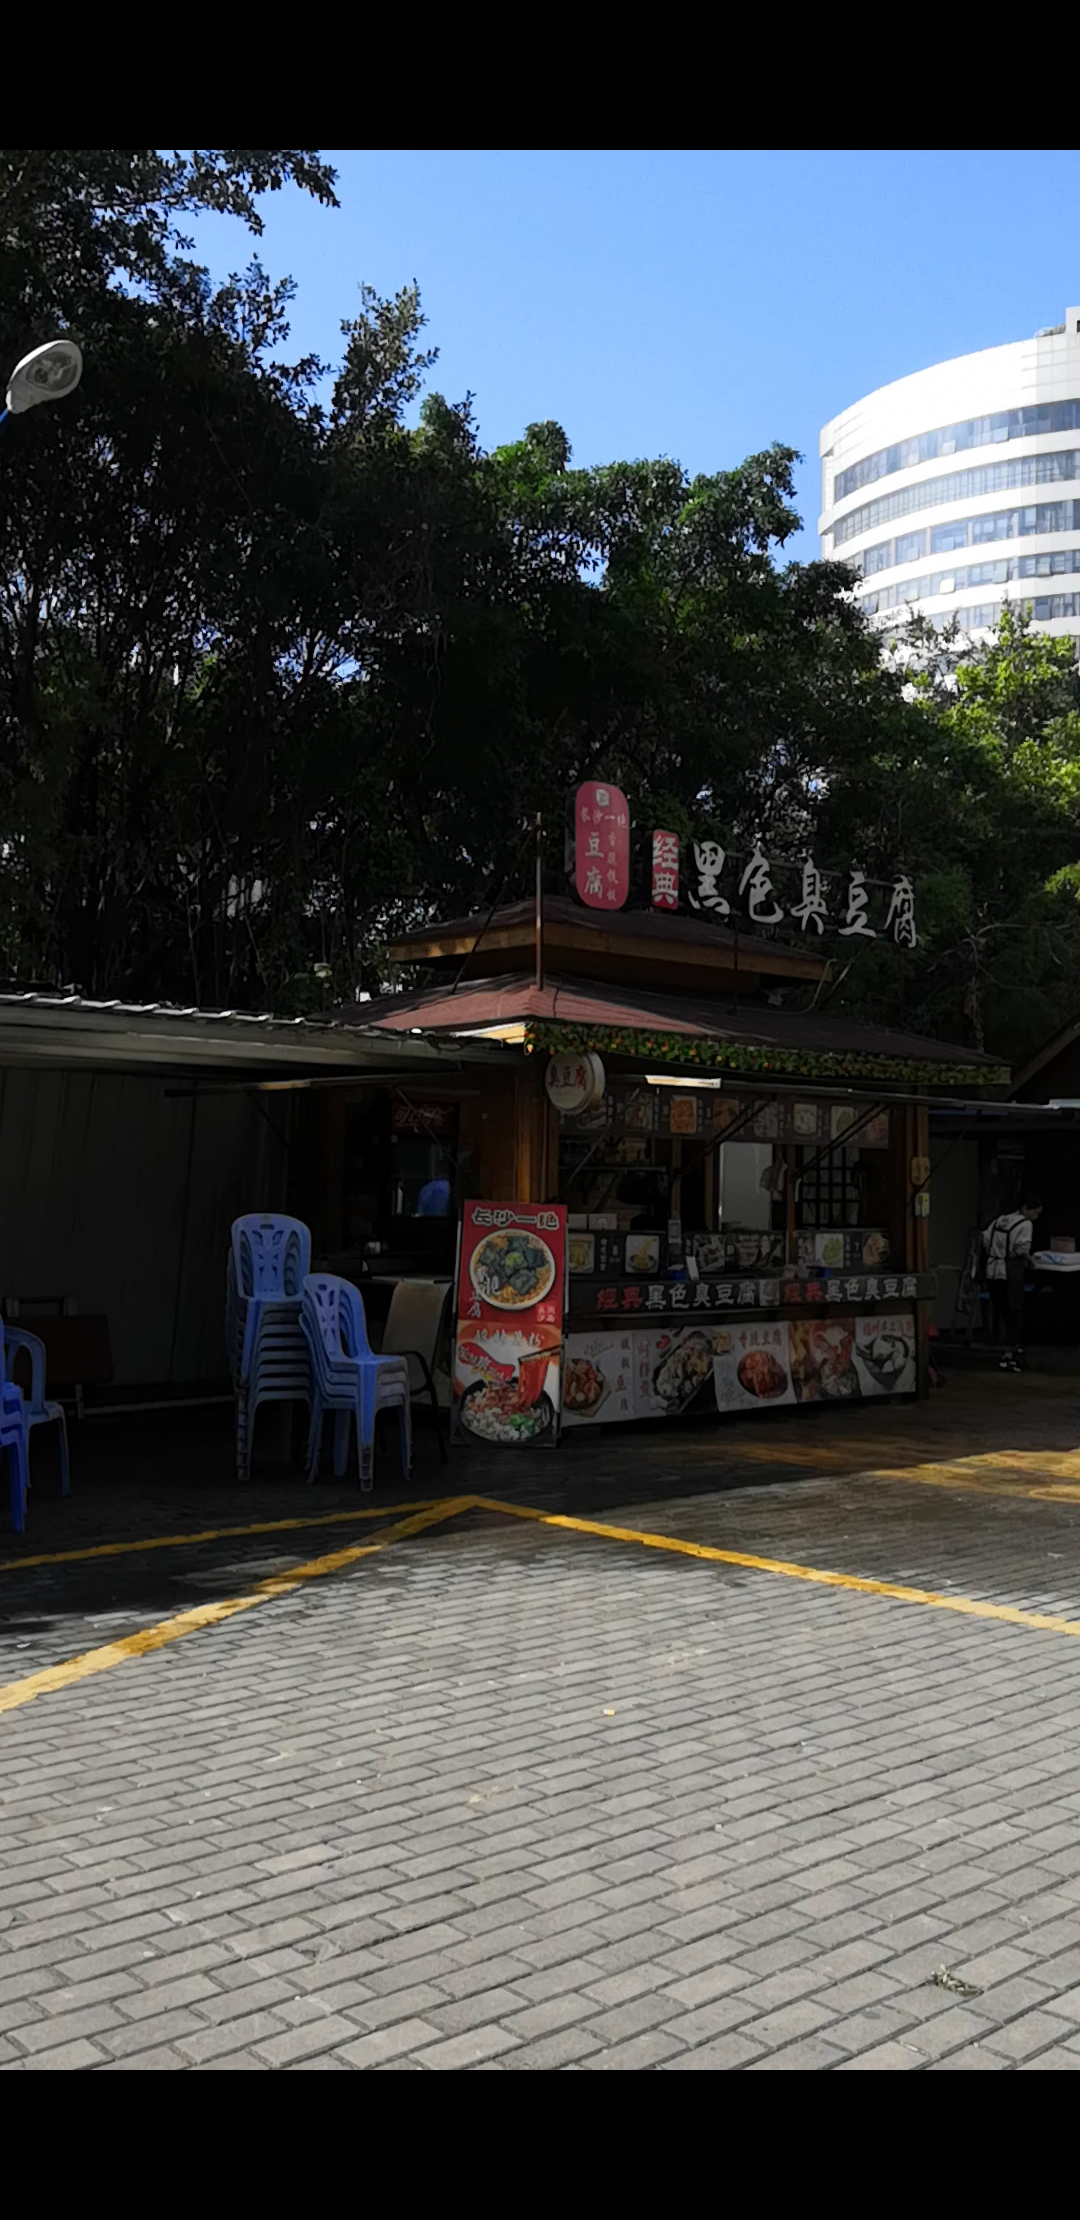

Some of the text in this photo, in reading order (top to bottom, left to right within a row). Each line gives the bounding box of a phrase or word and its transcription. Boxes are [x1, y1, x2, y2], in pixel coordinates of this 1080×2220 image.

[585, 832, 603, 899] 豆腐
[652, 834, 679, 904] 经典
[688, 840, 917, 949] 黑色臭豆腐
[549, 1065, 586, 1090] 臭豆腐
